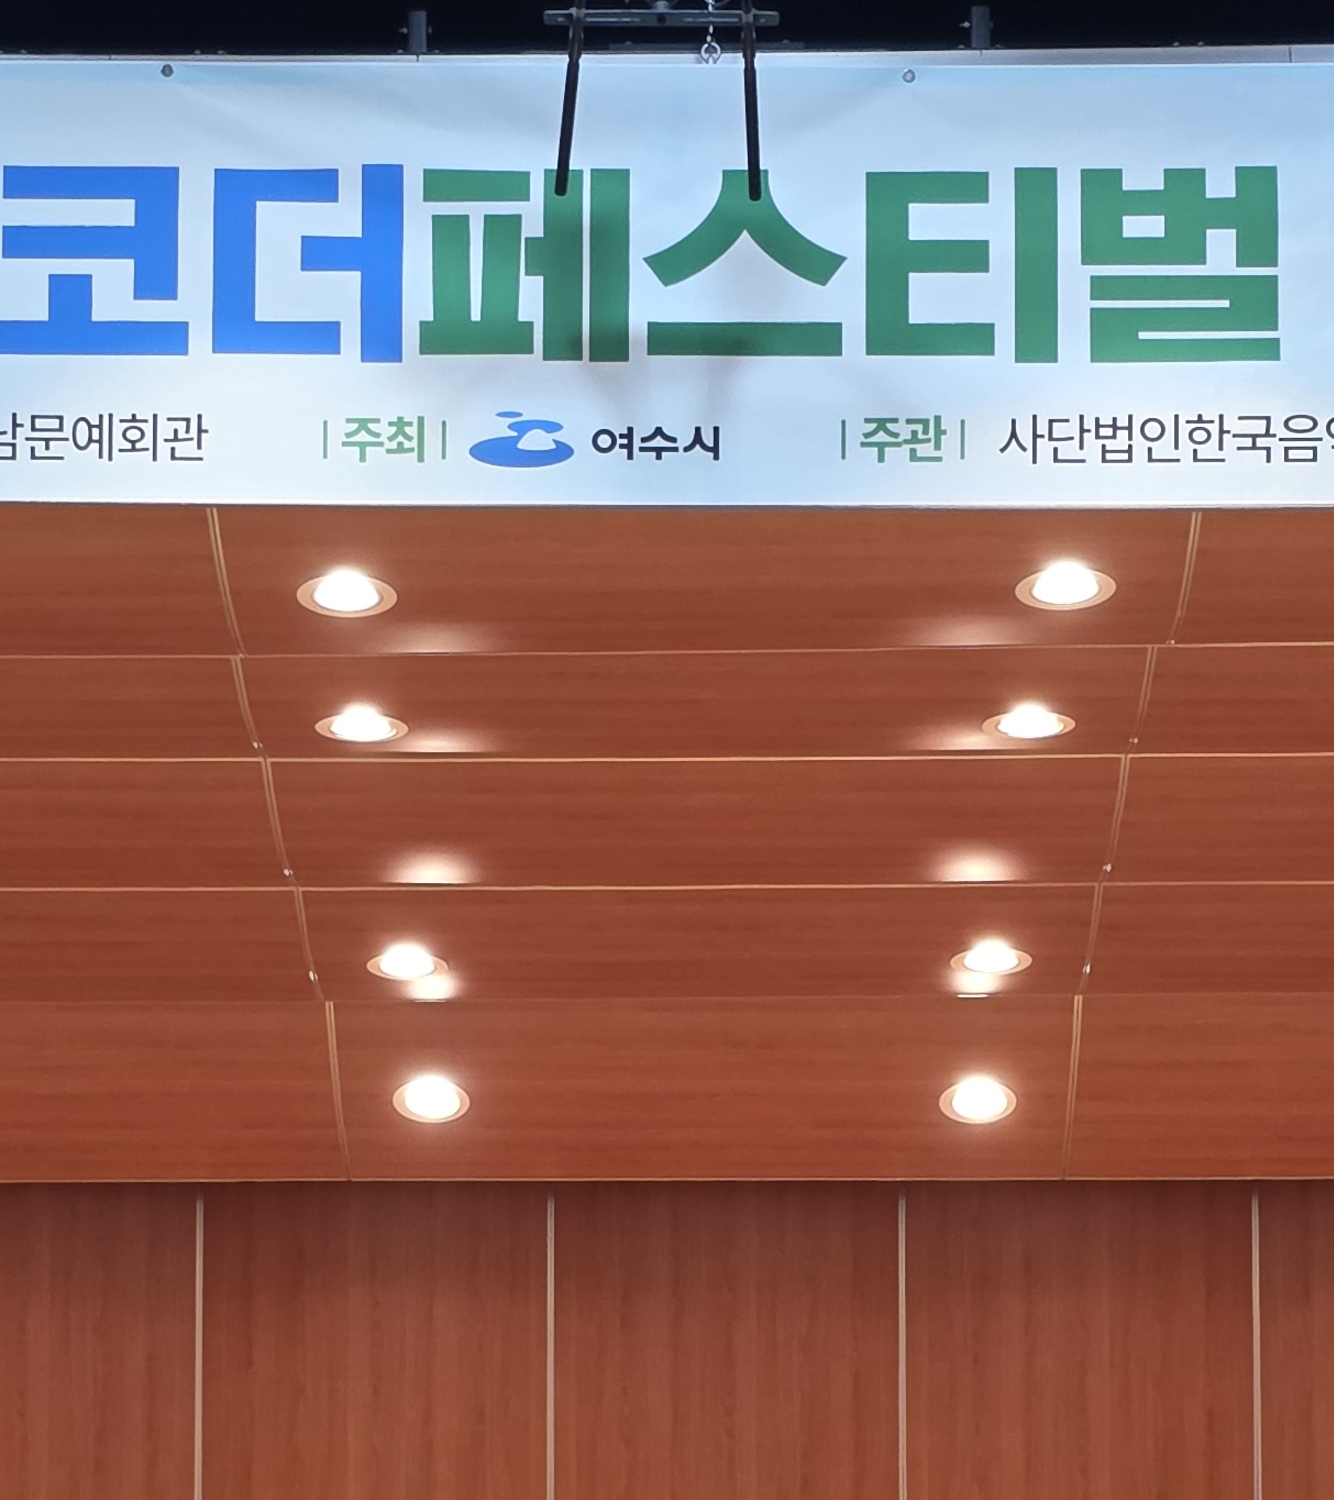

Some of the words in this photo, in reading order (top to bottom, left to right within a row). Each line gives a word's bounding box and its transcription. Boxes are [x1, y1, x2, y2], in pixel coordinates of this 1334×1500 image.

[341, 415, 426, 464] 주최
[591, 425, 720, 462] 여수시
[859, 414, 947, 464] 주관
